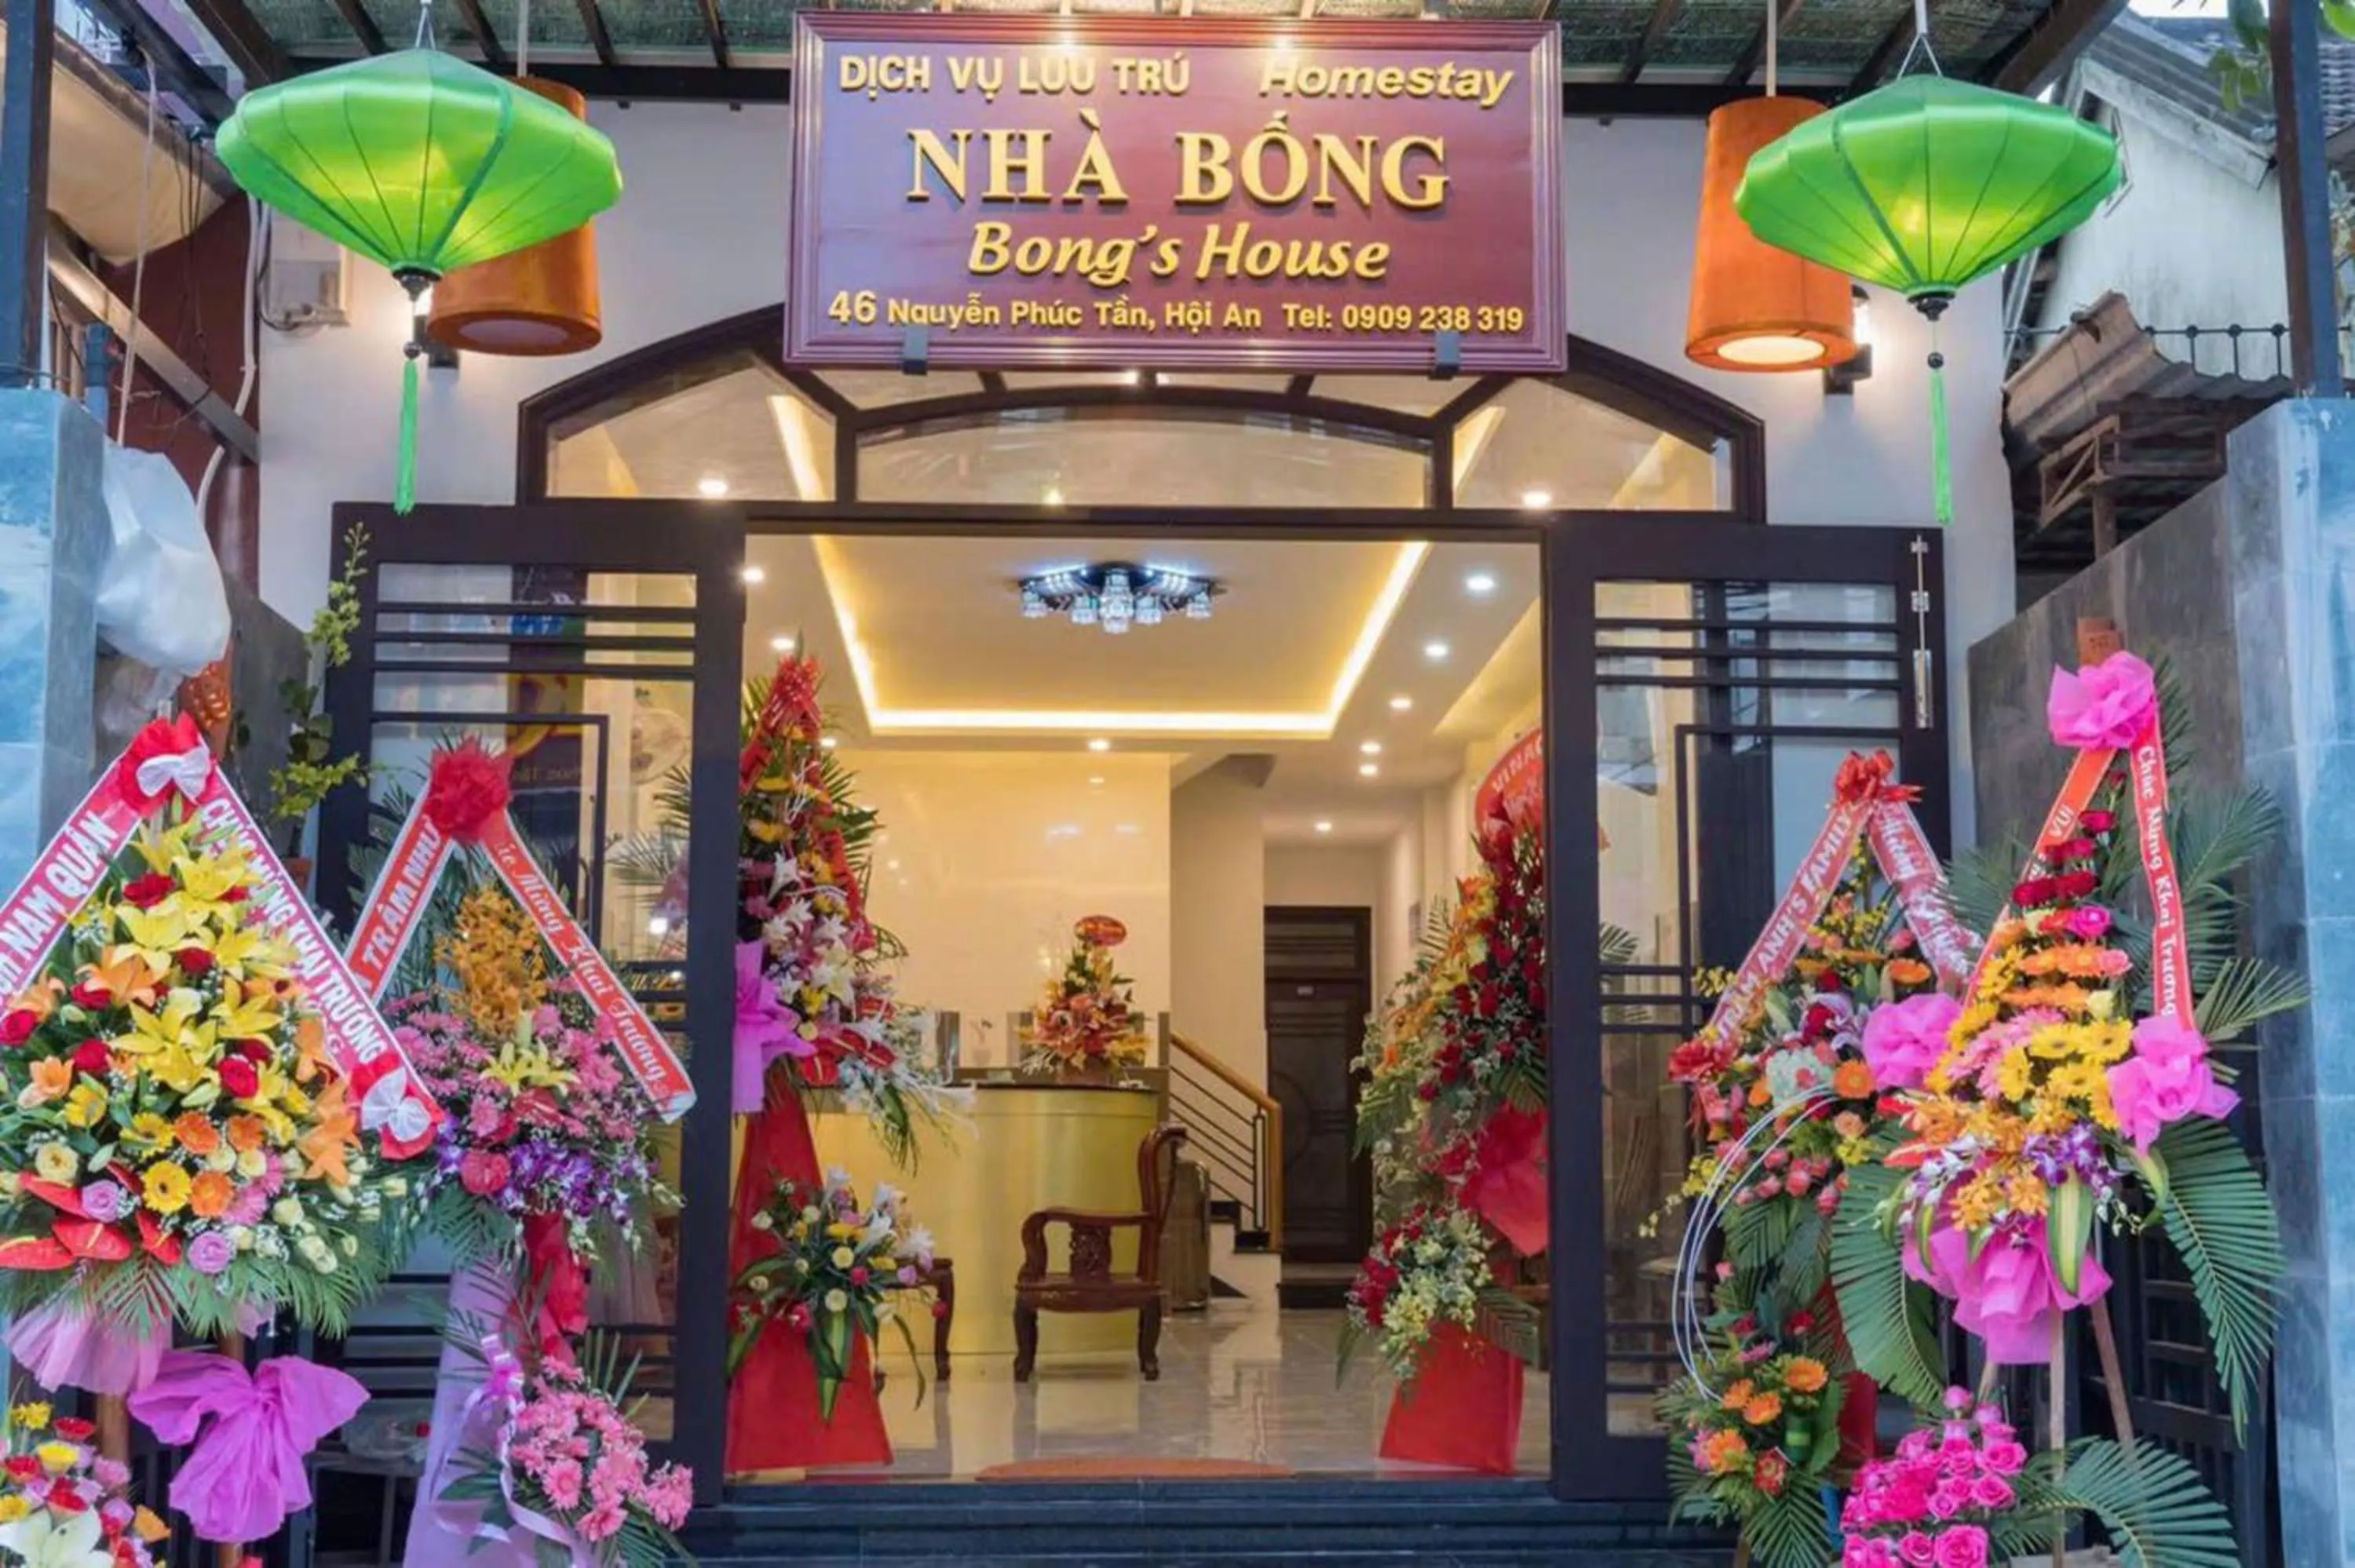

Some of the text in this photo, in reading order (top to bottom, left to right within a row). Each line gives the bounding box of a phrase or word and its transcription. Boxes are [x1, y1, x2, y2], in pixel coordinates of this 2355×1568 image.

[839, 55, 931, 100] DỊCH
[947, 57, 1003, 103] VỤ
[1113, 52, 1190, 97] TRÚ
[1258, 59, 1514, 110] Homestay
[907, 108, 1450, 208] NHÀ BỐNG
[966, 221, 1390, 286] Bong's House
[827, 290, 877, 325] 46
[1010, 298, 1083, 327] Phúc
[1164, 301, 1213, 333] Hội
[1221, 302, 1261, 328] An
[1282, 302, 1332, 330] Tel:
[1342, 304, 1412, 331] 0909
[1418, 305, 1471, 332] 238
[1477, 305, 1524, 333] 319
[0, 884, 68, 961] NAM
[362, 881, 418, 972] TRÂM
